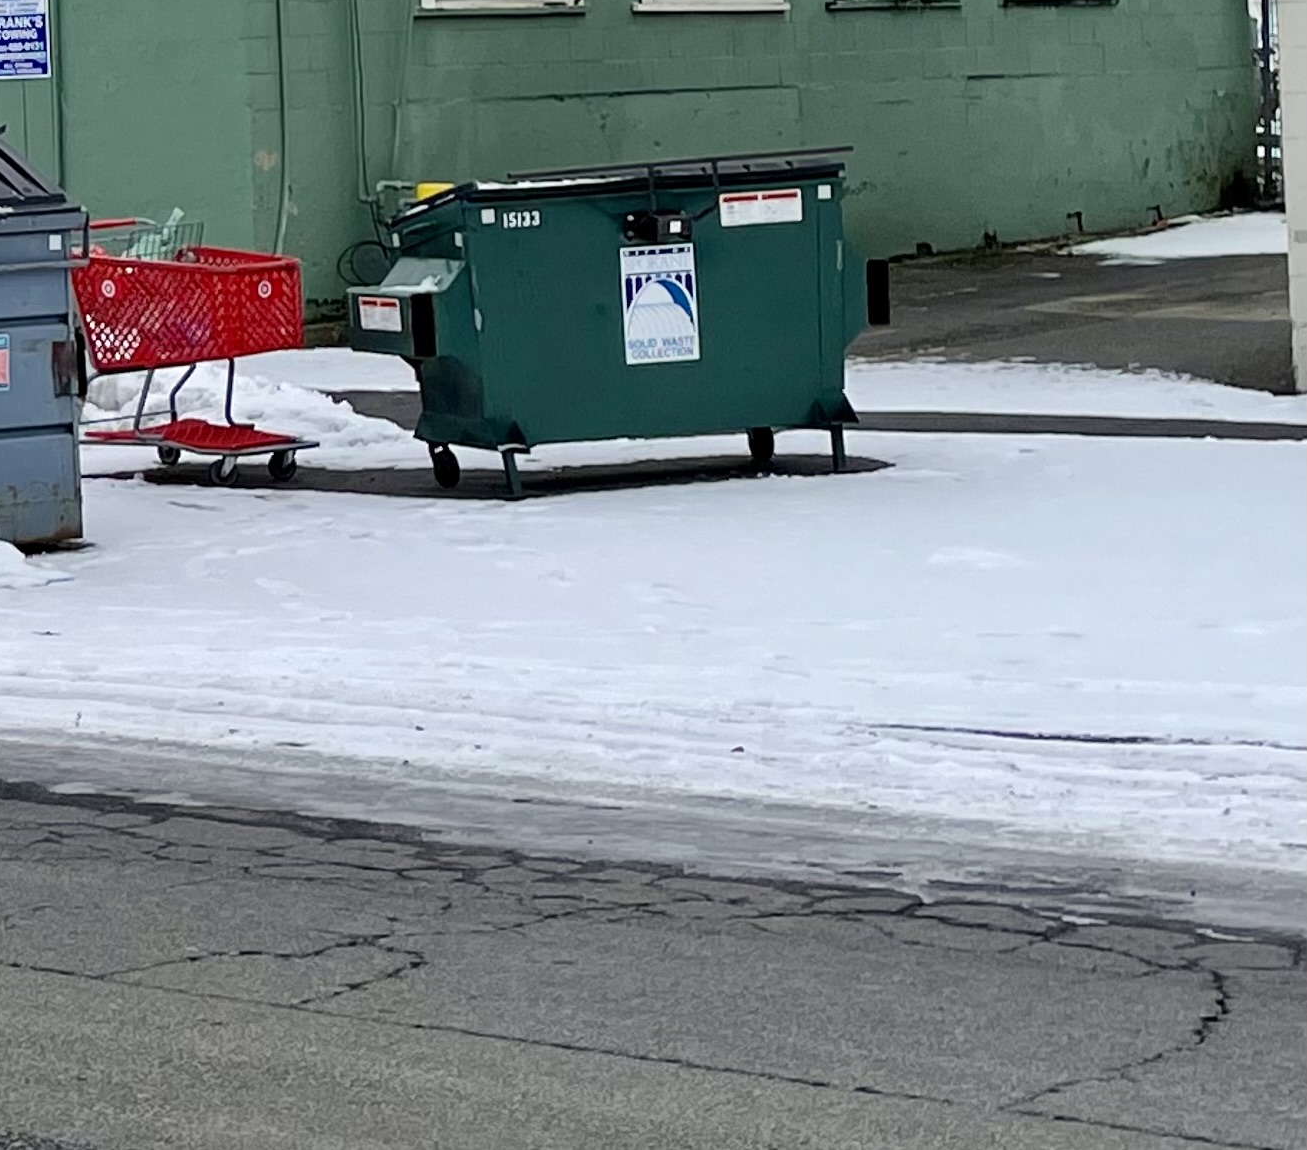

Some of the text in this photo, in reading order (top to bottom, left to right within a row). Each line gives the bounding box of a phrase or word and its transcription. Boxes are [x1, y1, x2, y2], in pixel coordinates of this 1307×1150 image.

[502, 210, 540, 228] 15133
[628, 337, 658, 349] SOLID
[631, 346, 694, 360] COLLECTION
